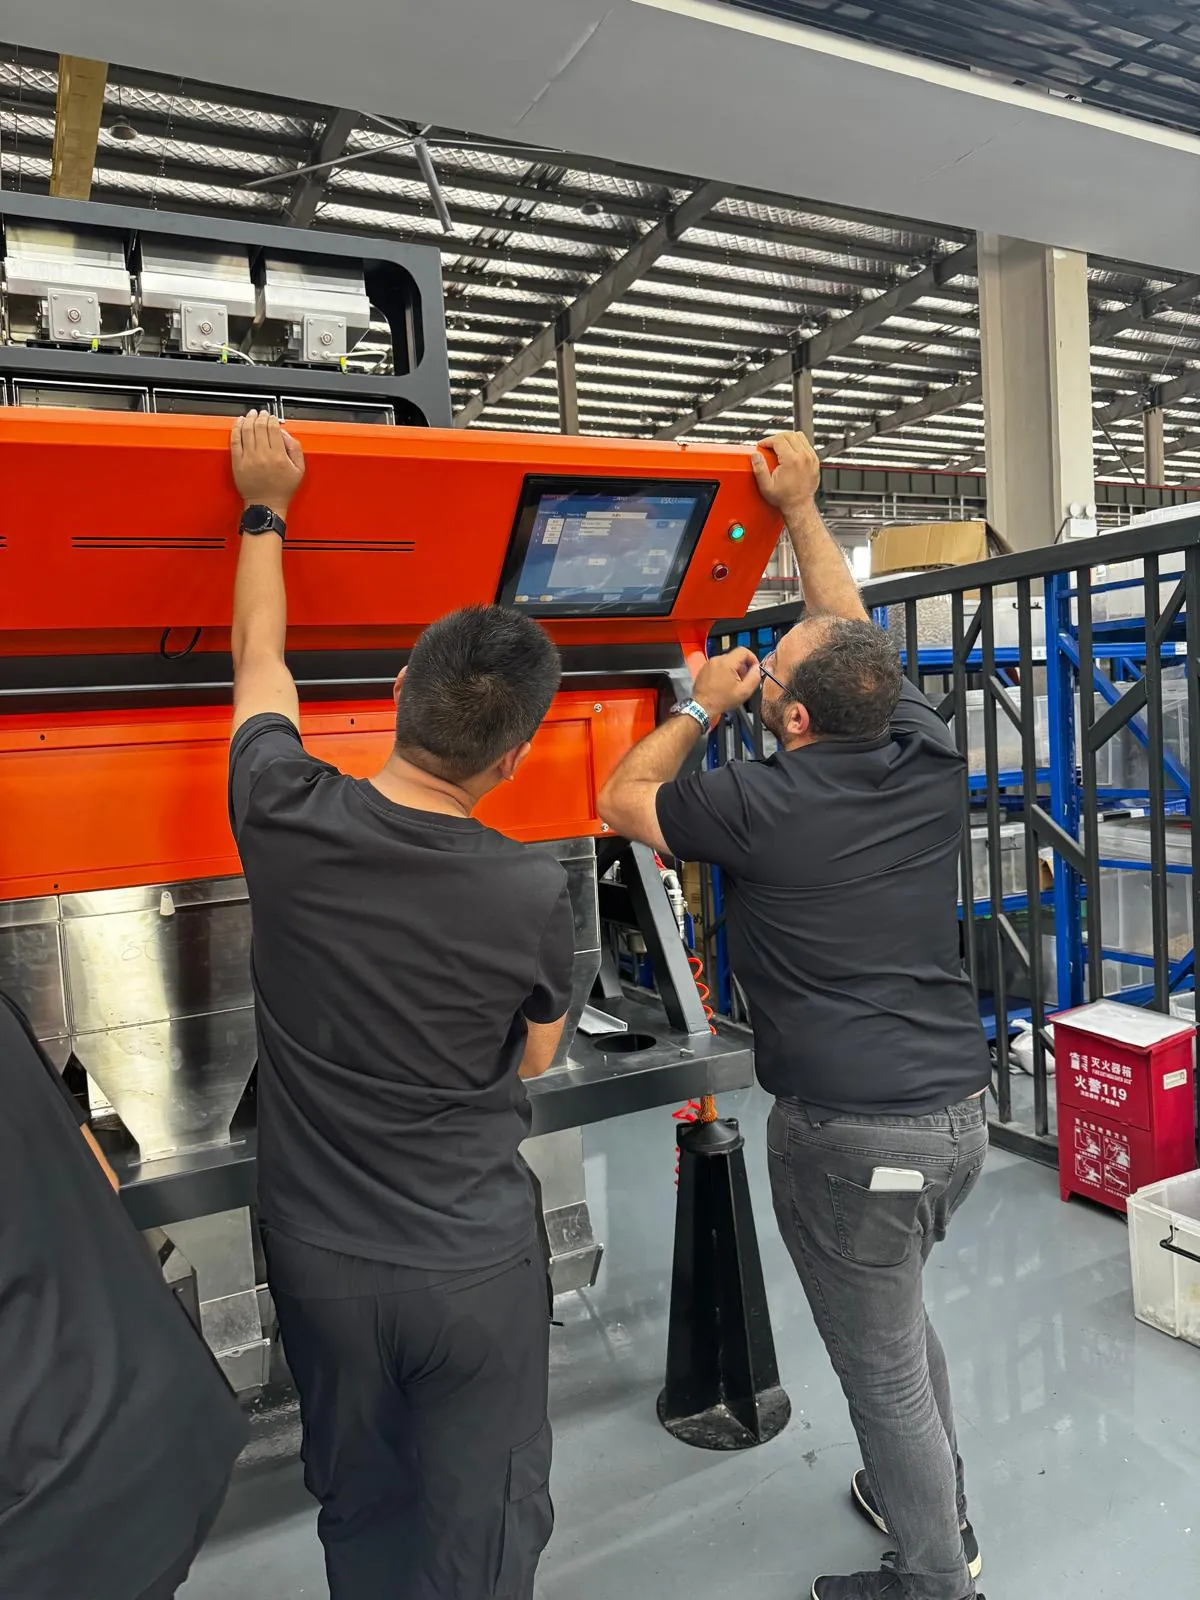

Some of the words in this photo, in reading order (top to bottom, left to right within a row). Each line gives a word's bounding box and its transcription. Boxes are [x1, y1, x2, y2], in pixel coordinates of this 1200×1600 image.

[1091, 1056, 1132, 1079] 灭火器箱
[1074, 1074, 1127, 1101] 火警119
